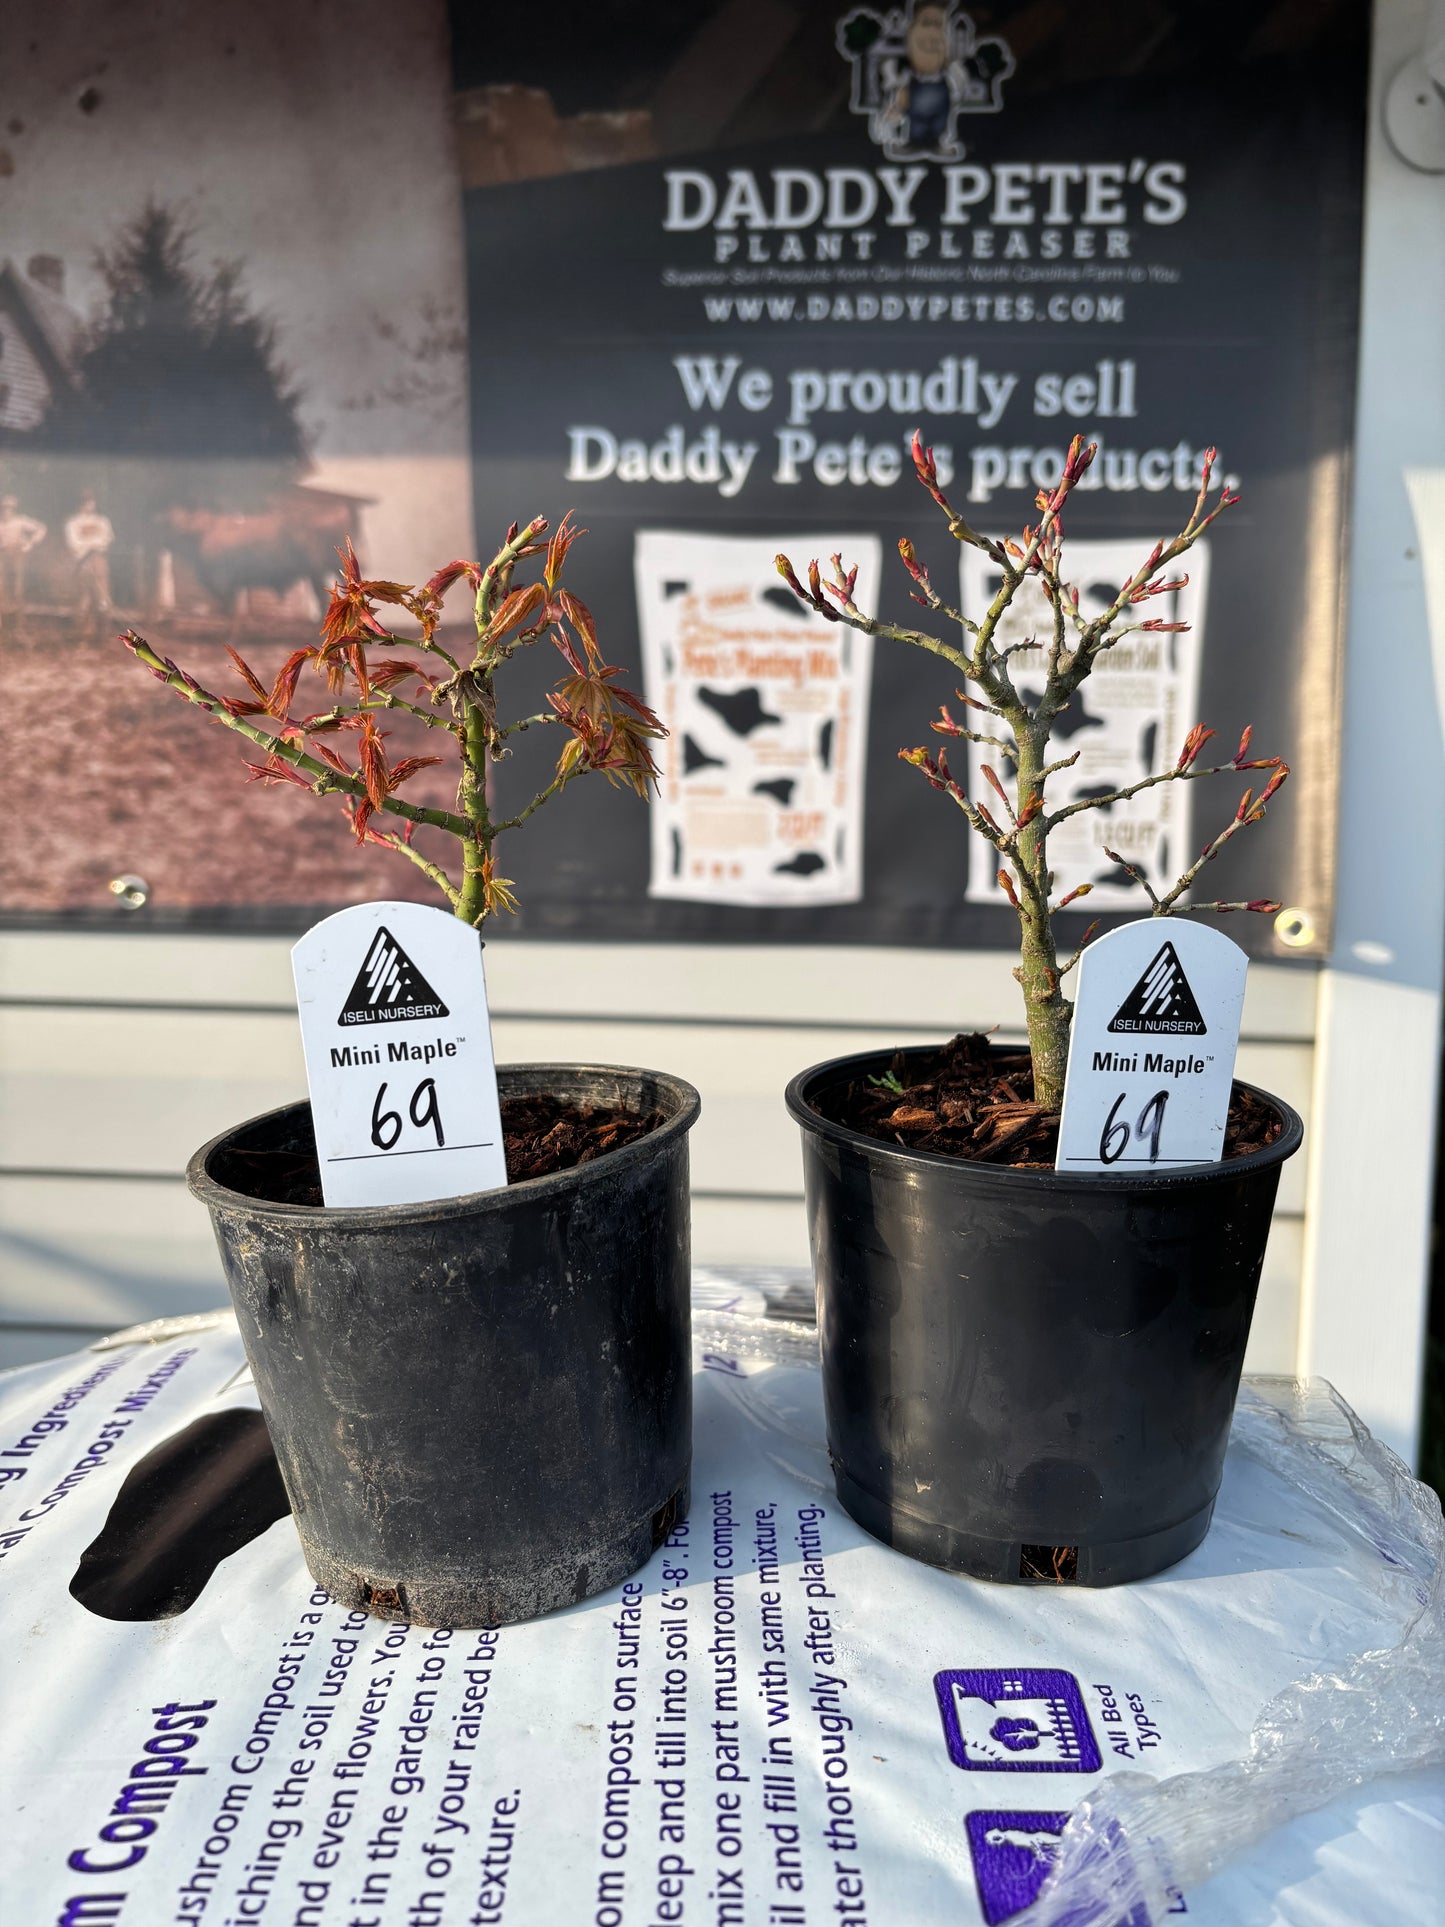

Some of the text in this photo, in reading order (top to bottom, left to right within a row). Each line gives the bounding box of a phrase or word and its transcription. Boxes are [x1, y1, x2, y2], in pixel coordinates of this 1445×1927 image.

[663, 159, 1188, 231] DADDY PETE'S
[714, 229, 1132, 262] PLANT PLEASER
[703, 295, 1124, 322] WWW.DADDYPETES.COM
[672, 354, 1138, 429] We proudly sell
[564, 424, 758, 498] Daddy
[343, 1004, 442, 1023] ISELI NURSERY
[1113, 1019, 1202, 1032] ISELI NURSERY
[330, 1044, 381, 1068] Mini
[1092, 1051, 1137, 1073] Mini
[371, 1078, 445, 1150] 69
[1099, 1090, 1169, 1165] 69
[19, 1419, 133, 1522] Compost
[114, 1347, 199, 1413] Mixture
[752, 1502, 780, 1584] mixture,
[795, 1503, 836, 1598] planting.
[613, 1582, 643, 1668] surface
[660, 1618, 688, 1660] soil
[760, 1591, 784, 1654] same
[804, 1606, 835, 1665] after
[231, 1653, 306, 1774] Compost
[282, 1631, 315, 1647] is
[300, 1613, 324, 1625] a
[416, 1656, 446, 1682] to
[613, 1676, 637, 1711] on
[656, 1669, 688, 1721] into
[758, 1660, 789, 1727] with
[273, 1759, 316, 1809] the
[299, 1705, 336, 1750] soil
[318, 1638, 360, 1696] used
[340, 1610, 369, 1631] to
[333, 1670, 395, 1779] flowers.
[390, 1690, 438, 1795] garden
[452, 1669, 492, 1750] raised
[708, 1490, 750, 1927] mix one part mushroom compost
[1092, 1684, 1135, 1759] All Bed
[1125, 1692, 1162, 1751] Types
[655, 1732, 686, 1768] till
[762, 1736, 794, 1765] in
[809, 1672, 857, 1851] thoroughly
[67, 1699, 217, 1874] Compost
[434, 1759, 472, 1835] your
[601, 1720, 641, 1859] compost
[654, 1779, 685, 1843] and
[763, 1774, 797, 1812] fill
[313, 1790, 359, 1869] even
[367, 1805, 408, 1861] the
[422, 1842, 455, 1878] of
[470, 1789, 521, 1925] texture.
[766, 1823, 804, 1892] and
[350, 1872, 391, 1905] in
[648, 1854, 694, 1927] eep
